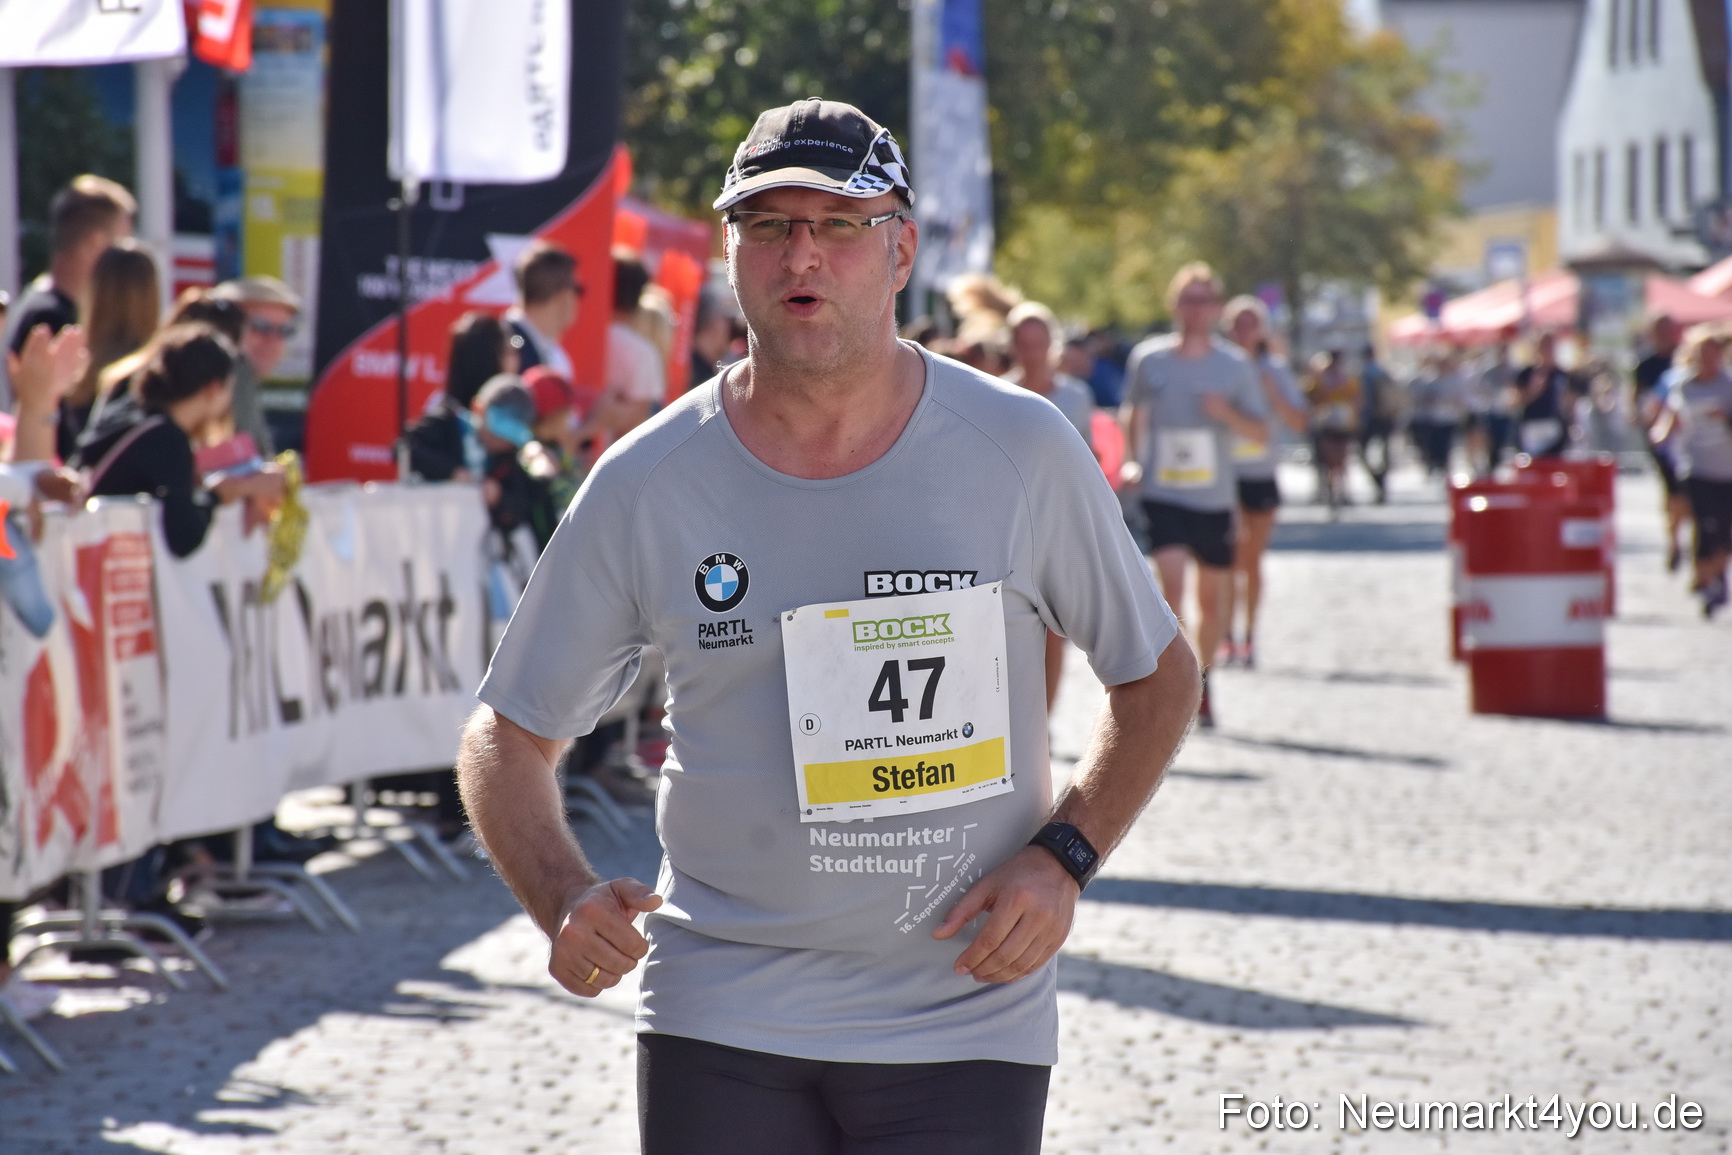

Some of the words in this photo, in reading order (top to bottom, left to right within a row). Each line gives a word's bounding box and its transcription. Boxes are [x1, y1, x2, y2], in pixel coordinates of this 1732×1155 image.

[793, 138, 855, 154] experience
[699, 554, 744, 575] BMW
[865, 570, 977, 596] BOCK
[698, 619, 753, 638] PARTL
[852, 613, 953, 643] BOCK
[699, 634, 754, 650] Neumarkt
[854, 642, 885, 652] inspired
[886, 642, 896, 650] by
[898, 640, 920, 648] smart
[922, 636, 955, 647] concepts
[868, 656, 946, 723] 47
[805, 718, 814, 731] D
[845, 736, 893, 751] PARTL
[896, 728, 958, 747] Neumarkt
[872, 761, 955, 793] Stefan
[809, 826, 954, 847] Neumarkter
[809, 853, 928, 877] Stadtlauf
[899, 920, 916, 935] 16.
[913, 875, 960, 924] September
[957, 853, 977, 877] 2018
